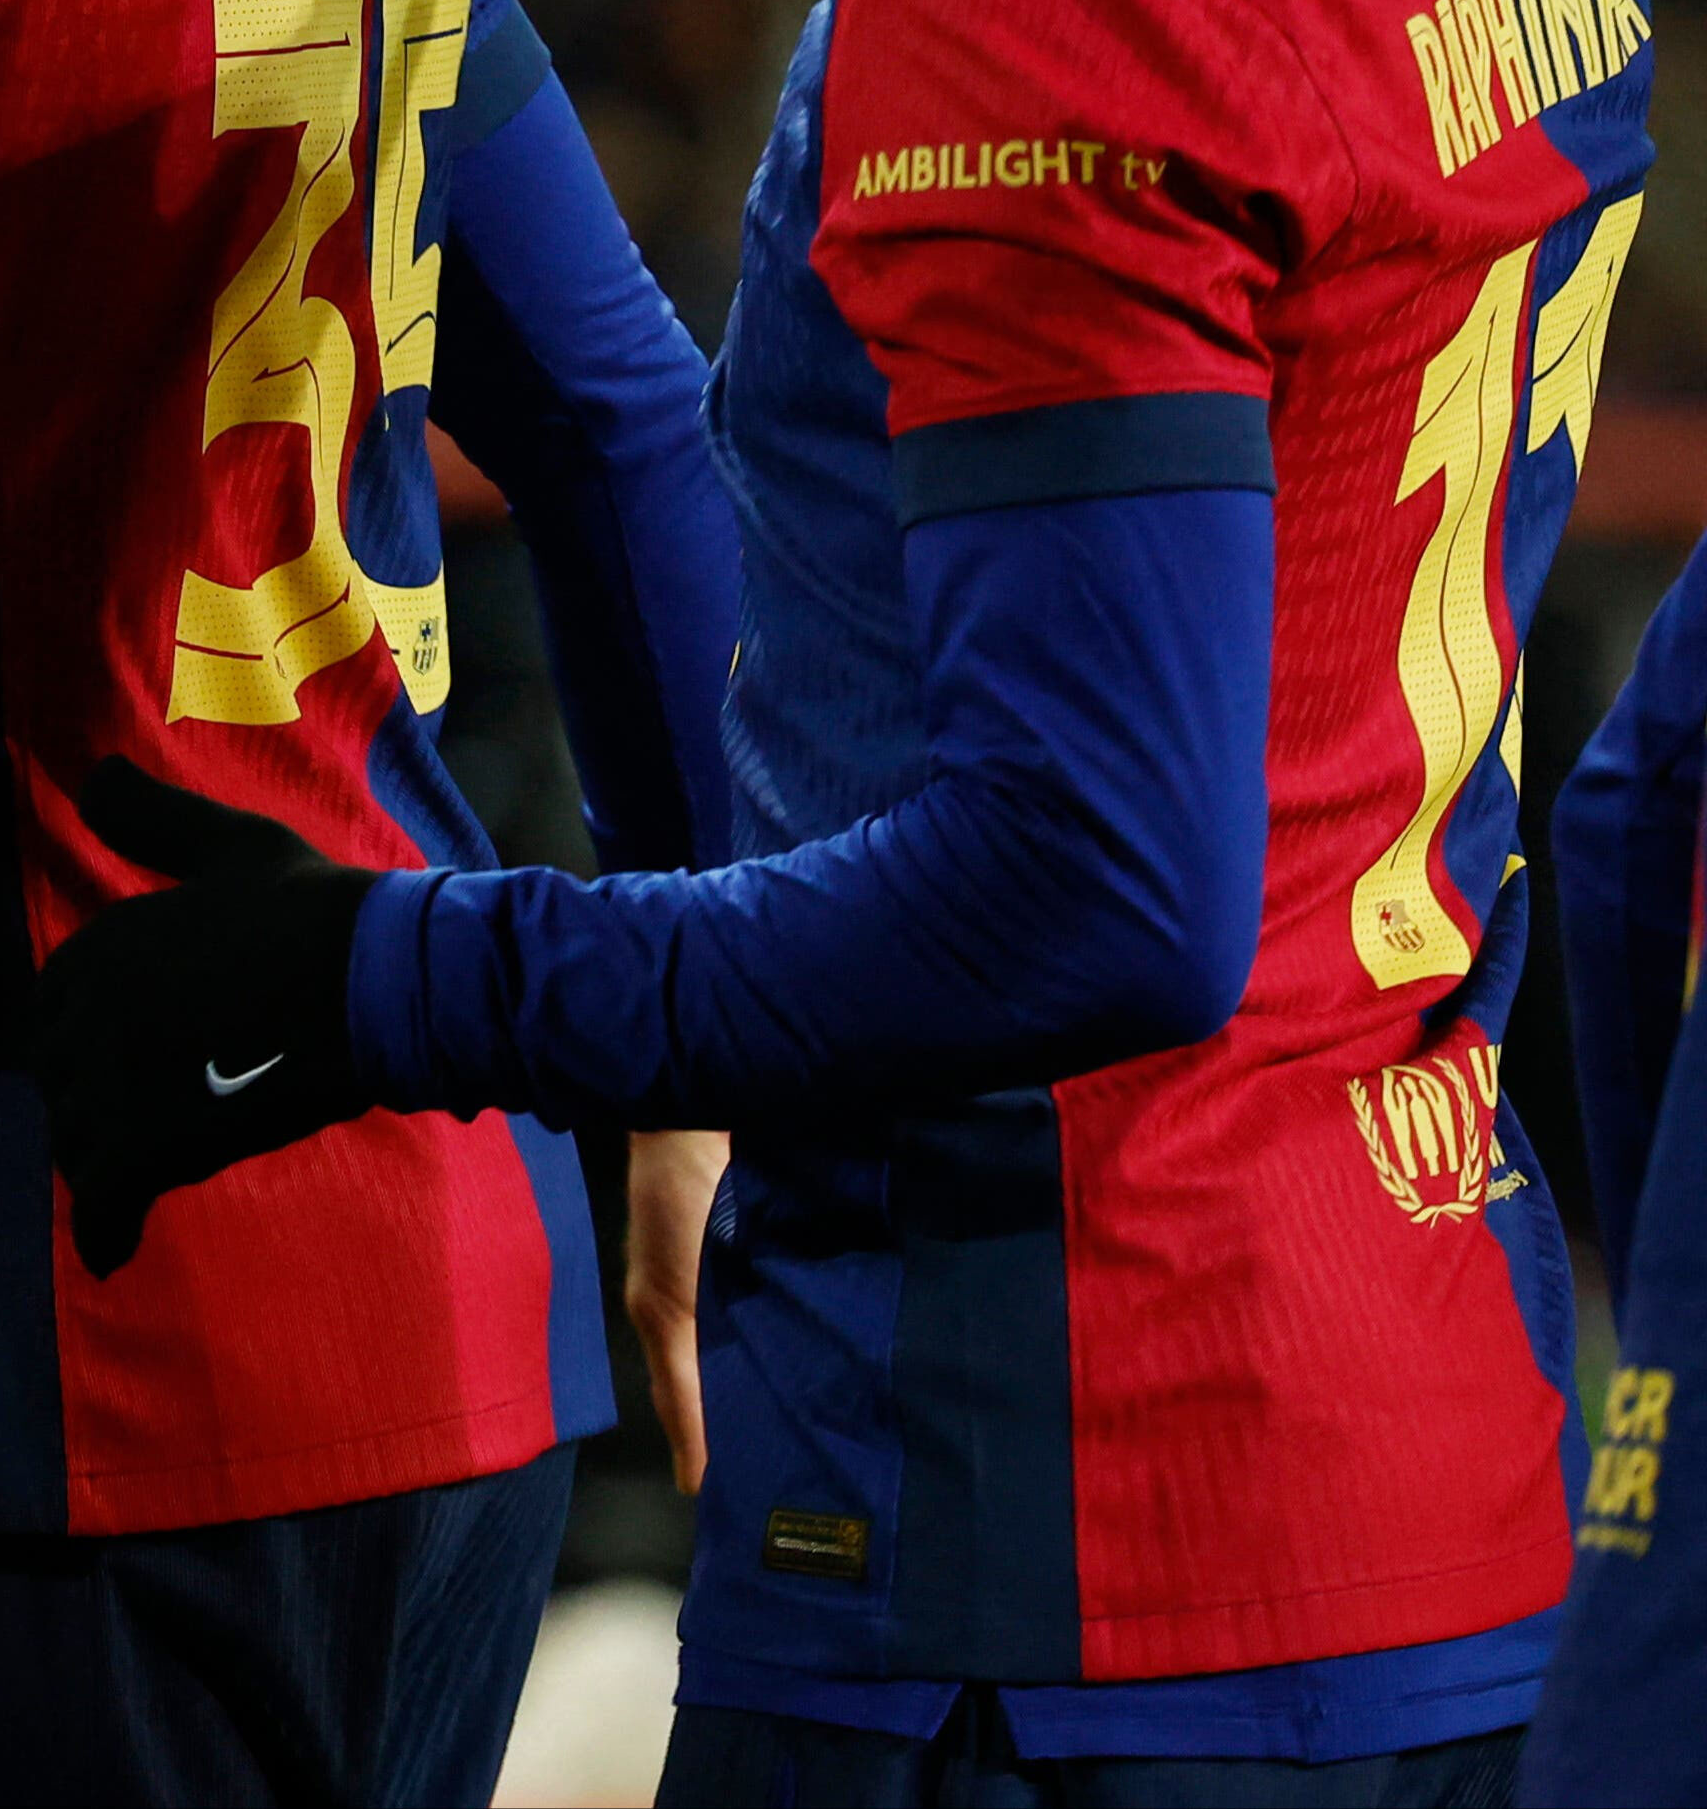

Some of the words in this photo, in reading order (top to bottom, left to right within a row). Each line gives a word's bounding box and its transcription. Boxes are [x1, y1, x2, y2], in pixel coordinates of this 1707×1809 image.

[853, 139, 1106, 201] AMBILIGHT
[1120, 151, 1167, 190] tv
[1350, 190, 1644, 990] 11
